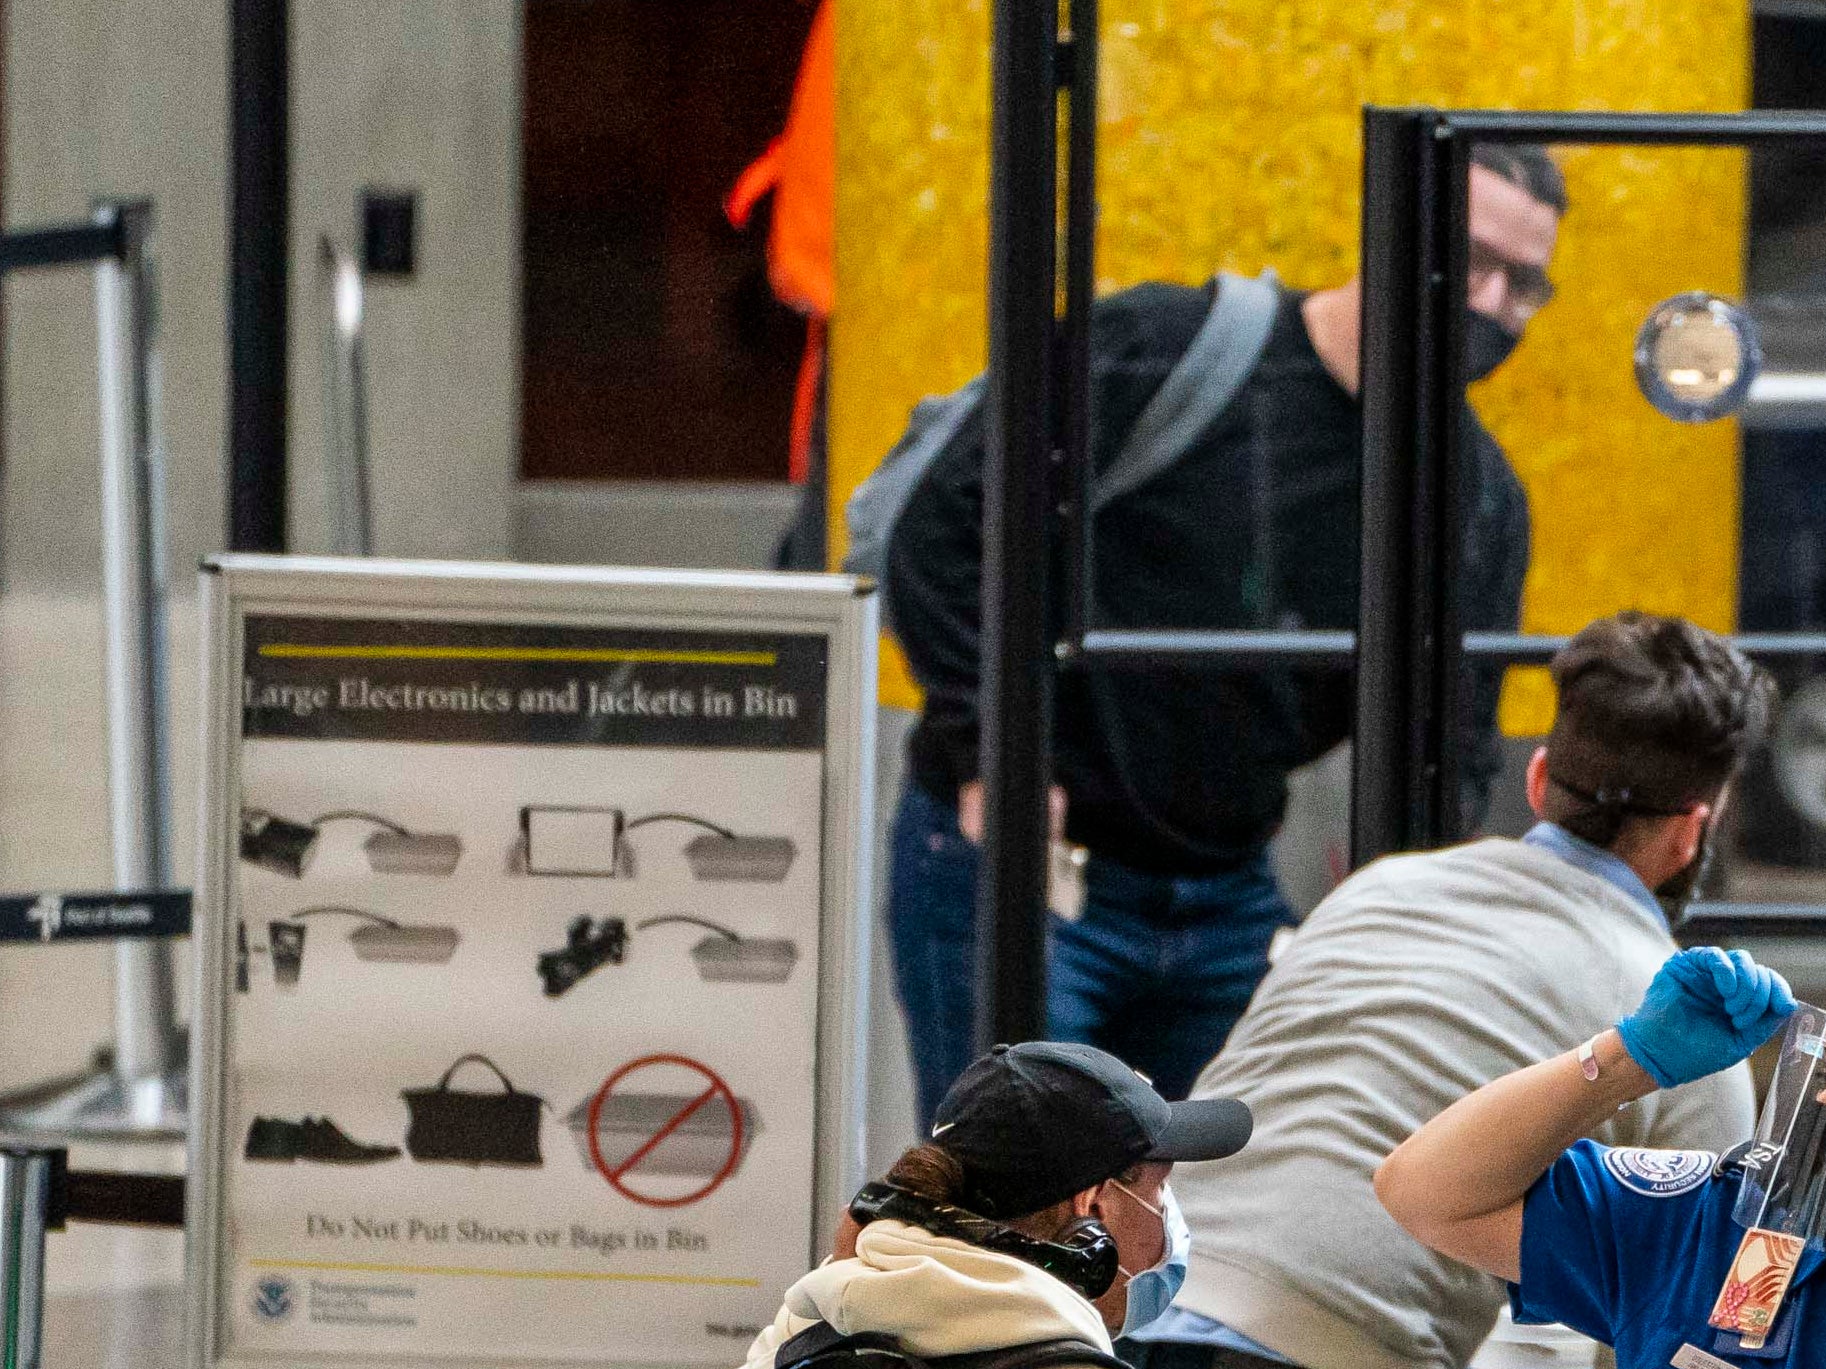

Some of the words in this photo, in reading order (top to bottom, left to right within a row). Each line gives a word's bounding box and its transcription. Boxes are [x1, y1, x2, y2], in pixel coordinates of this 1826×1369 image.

[242, 677, 329, 717] Large
[338, 676, 514, 713] Electronics
[518, 679, 580, 715] and
[586, 681, 696, 718] Jackets
[702, 684, 736, 718] in
[743, 684, 799, 719] Bin
[1650, 1173, 1697, 1192] SECURITY
[306, 1213, 346, 1239] Do
[351, 1214, 400, 1241] Not
[406, 1217, 451, 1243] Put
[456, 1218, 529, 1246] Shoes
[534, 1228, 562, 1248] or
[569, 1224, 628, 1257] Bags
[633, 1228, 660, 1251] in
[665, 1226, 708, 1252] Bin
